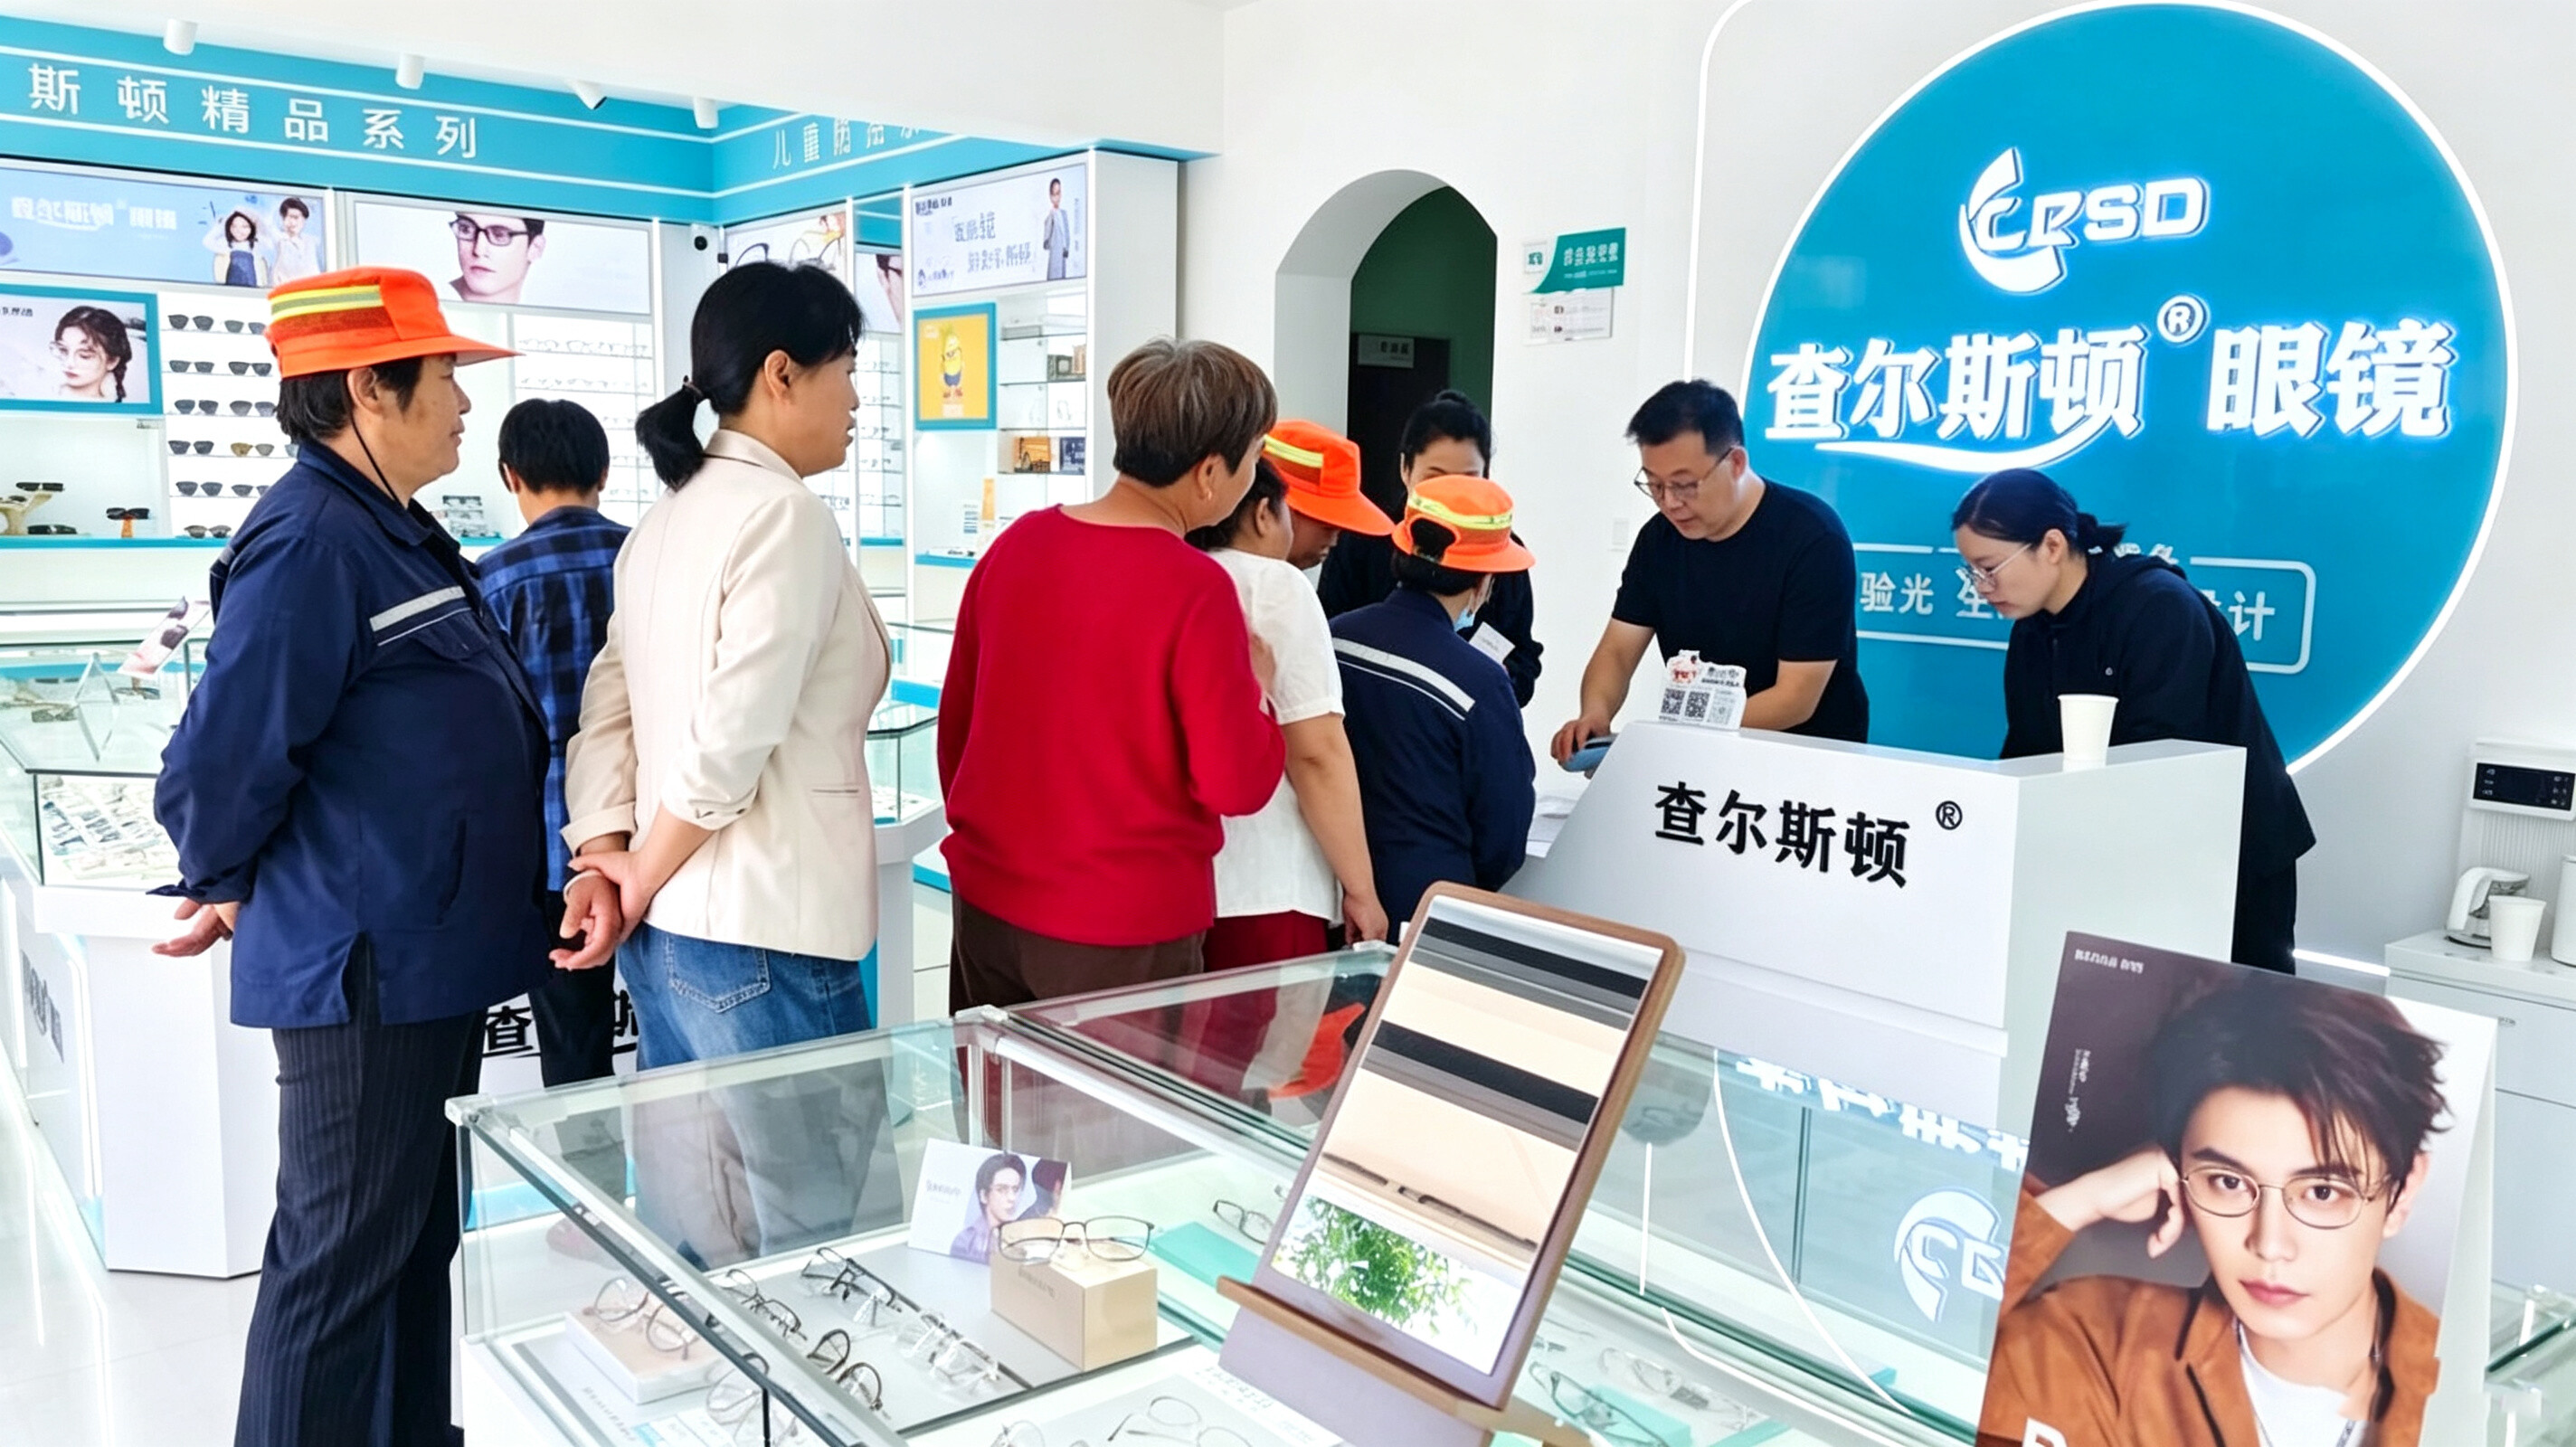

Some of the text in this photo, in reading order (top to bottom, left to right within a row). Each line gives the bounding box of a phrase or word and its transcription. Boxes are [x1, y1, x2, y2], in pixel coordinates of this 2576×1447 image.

[28, 62, 478, 159] 斯顿精品系列
[1859, 572, 1935, 616] 验光
